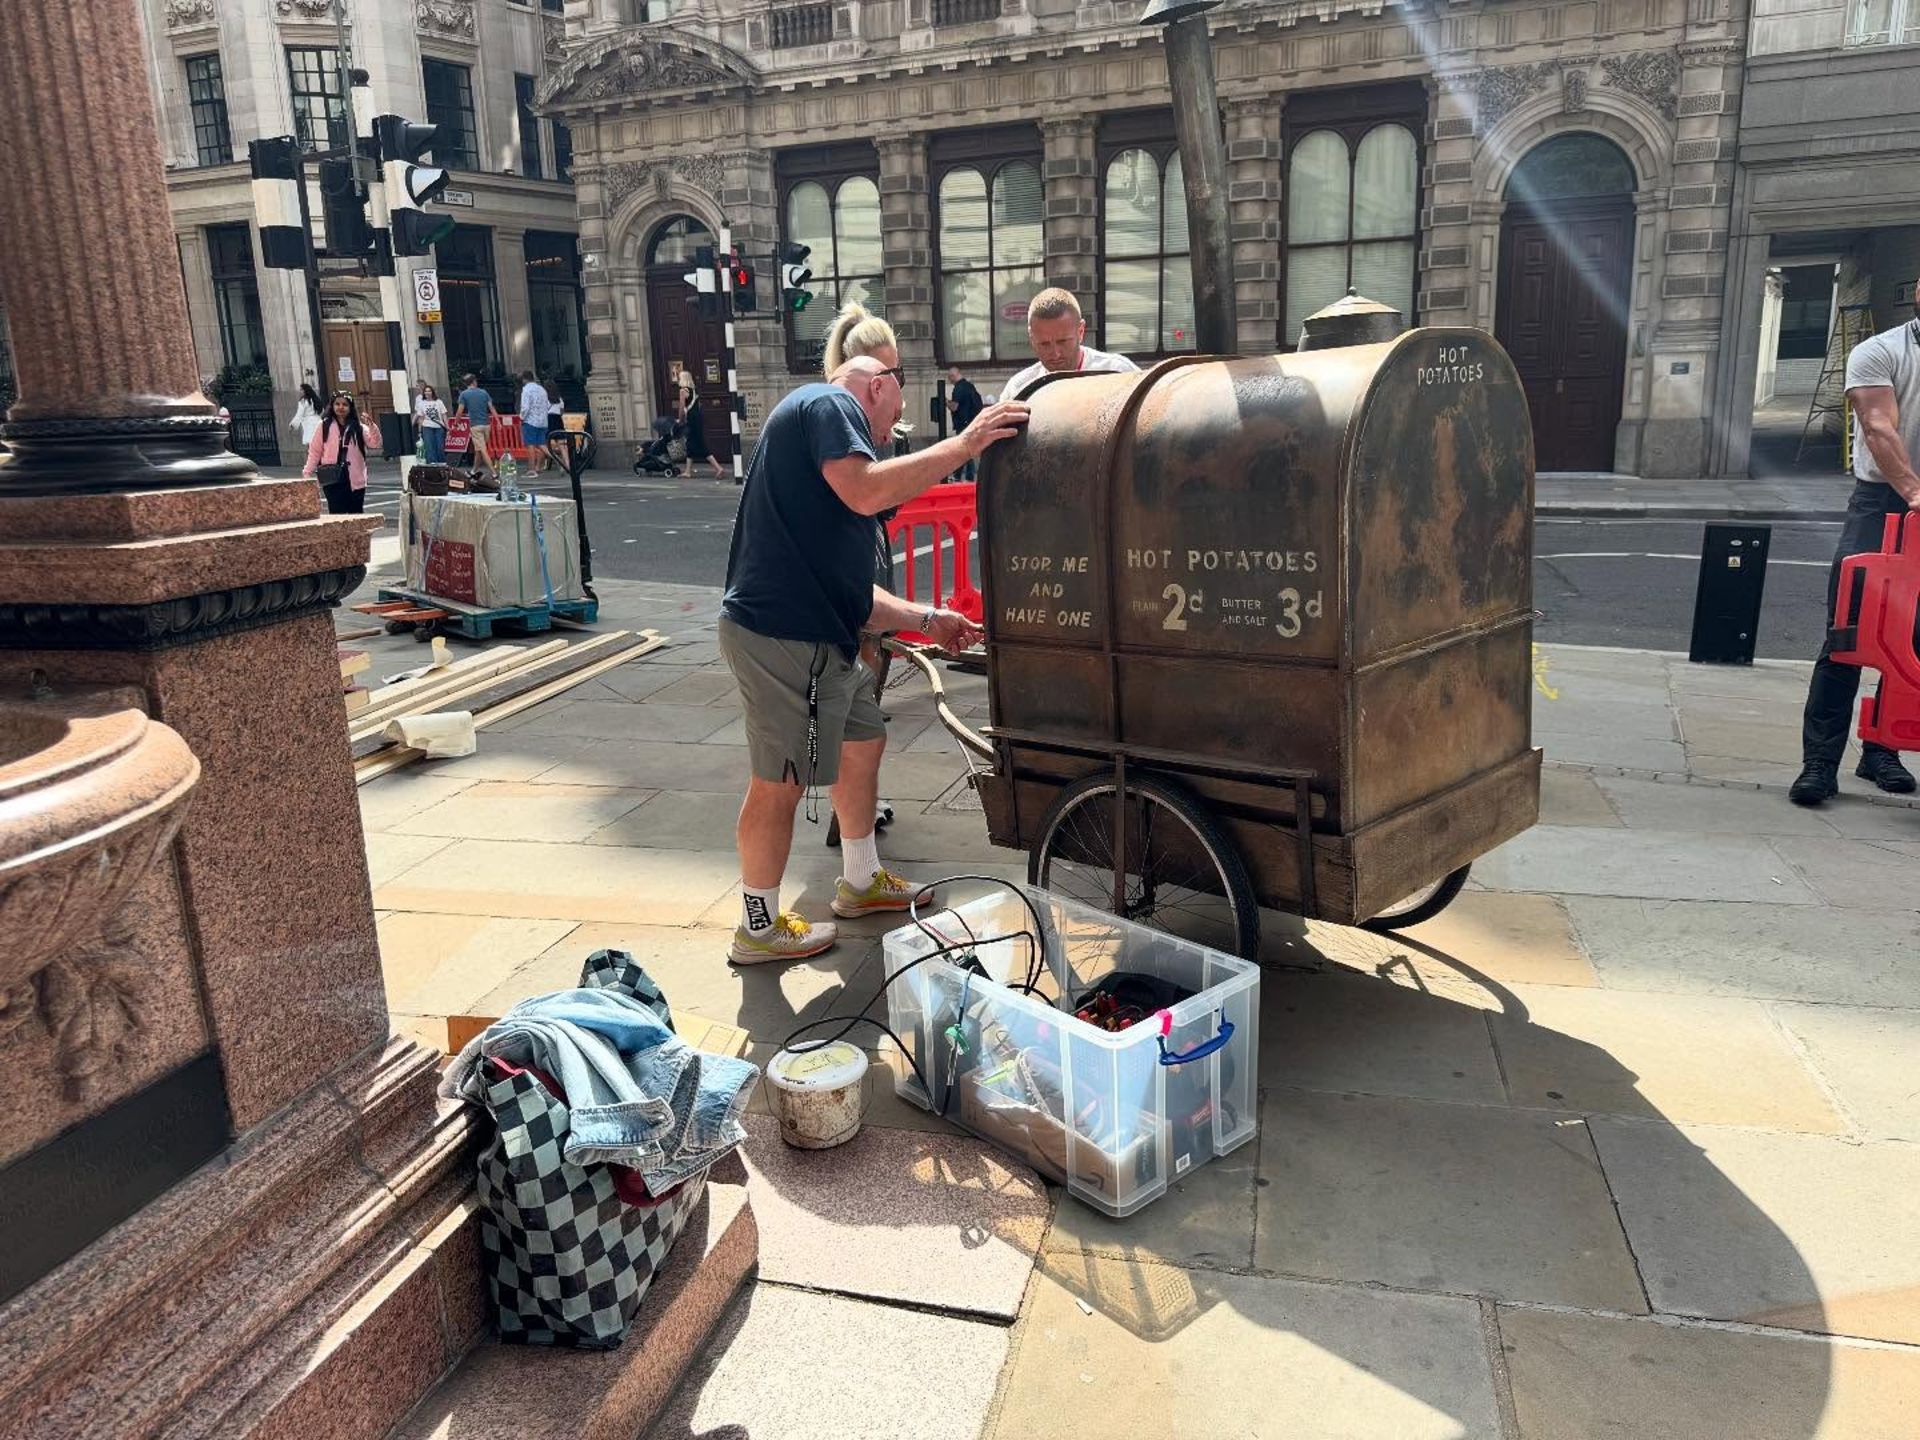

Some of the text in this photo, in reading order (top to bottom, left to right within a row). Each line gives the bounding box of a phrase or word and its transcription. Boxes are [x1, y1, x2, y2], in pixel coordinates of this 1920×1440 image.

[1439, 346, 1468, 363] HOT
[1417, 363, 1484, 386] POTATOES
[1010, 555, 1089, 573] STOP ME
[1127, 548, 1318, 572] HOT POTATOES
[1029, 583, 1064, 598] AND
[1161, 583, 1204, 631] 2d
[1222, 598, 1262, 610] BUTTER
[1275, 587, 1323, 638] 3d
[1005, 607, 1092, 628] HAVE ONE
[1222, 614, 1269, 627] AND SALT
